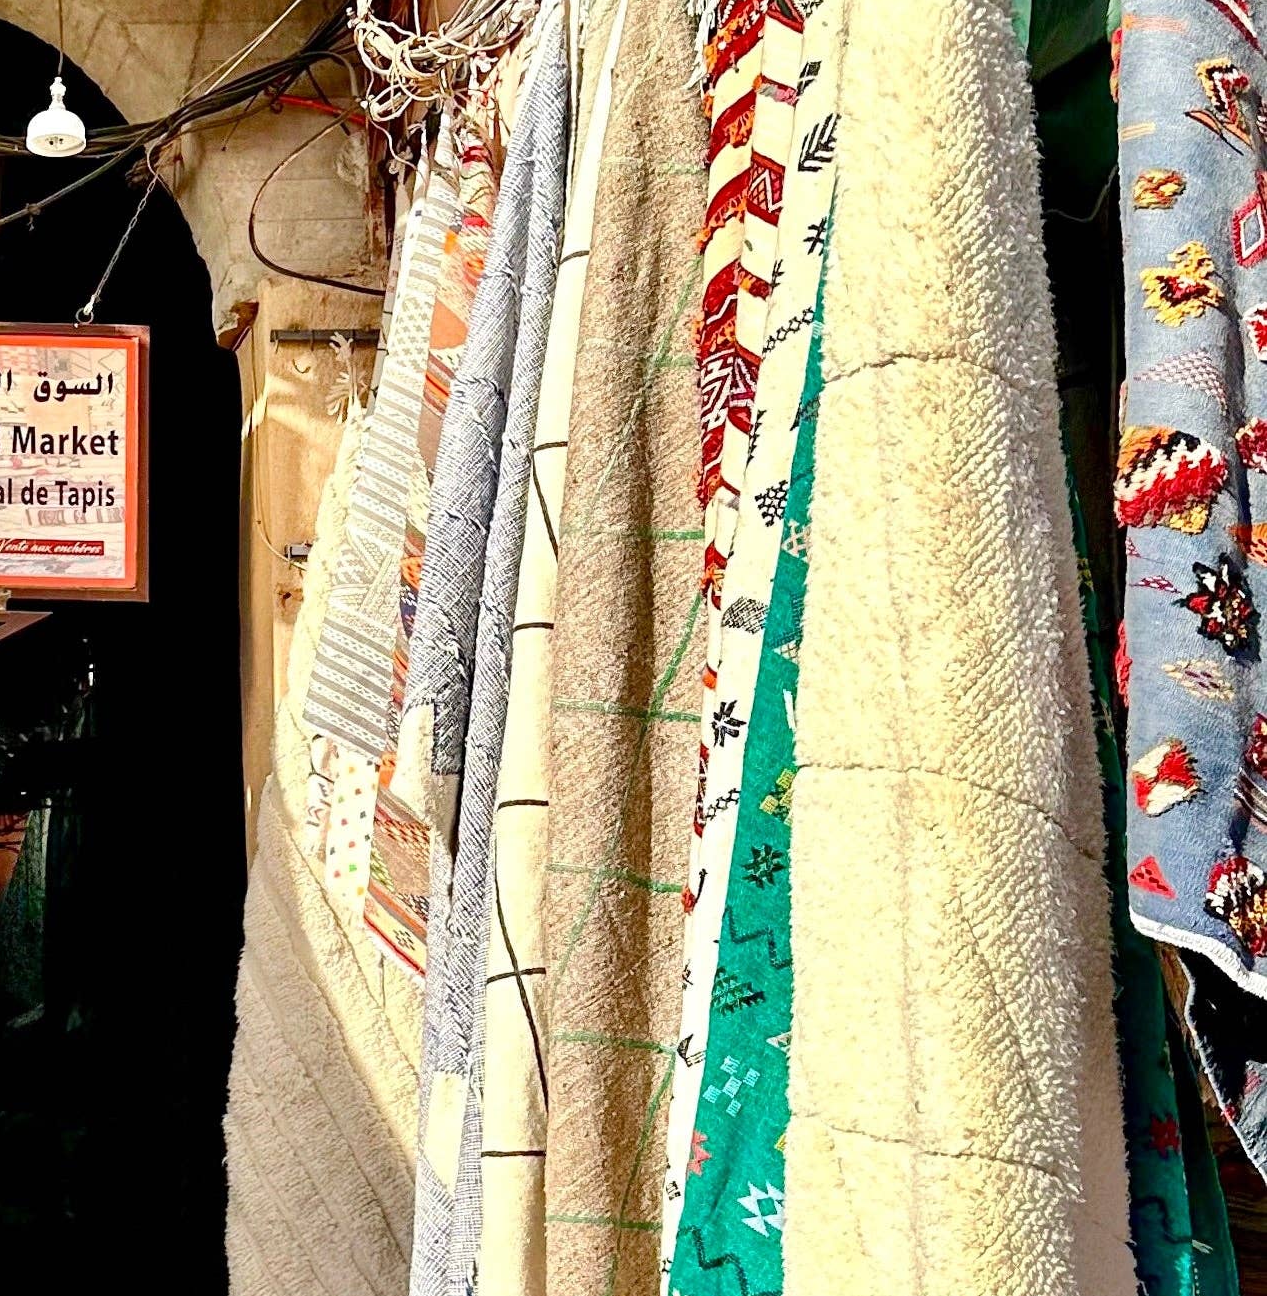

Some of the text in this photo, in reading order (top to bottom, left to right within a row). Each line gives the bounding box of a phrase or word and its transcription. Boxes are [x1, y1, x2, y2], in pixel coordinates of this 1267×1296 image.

[33, 370, 113, 402] السوق
[12, 425, 119, 457] Market
[21, 479, 48, 506] de
[55, 480, 115, 513] Tapis
